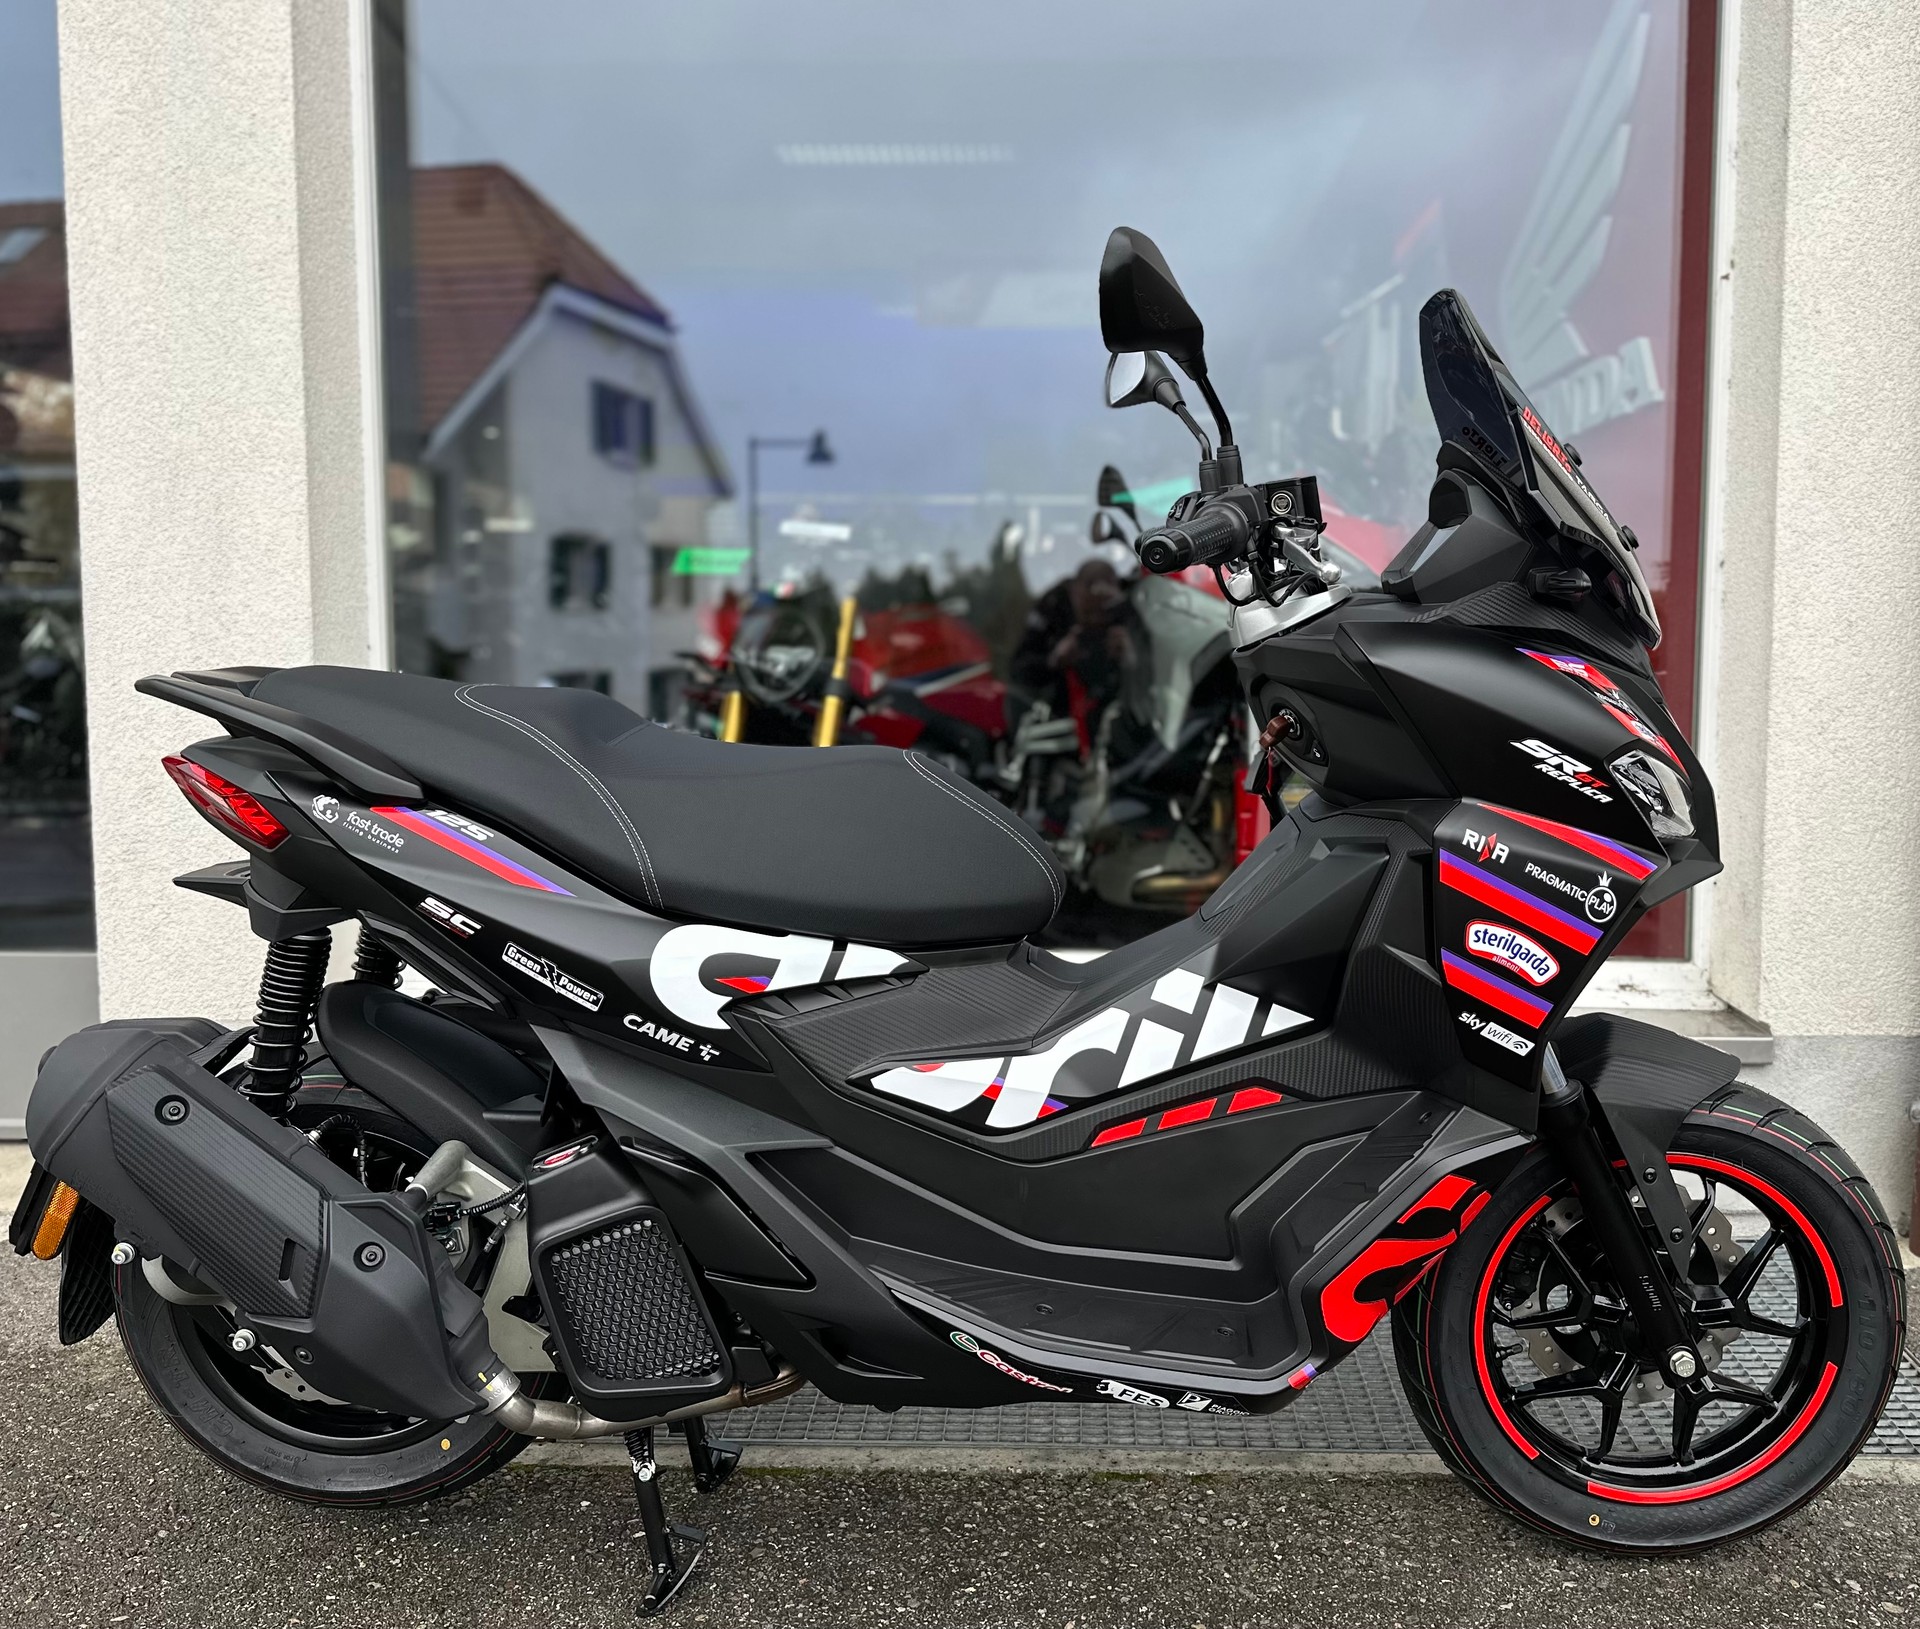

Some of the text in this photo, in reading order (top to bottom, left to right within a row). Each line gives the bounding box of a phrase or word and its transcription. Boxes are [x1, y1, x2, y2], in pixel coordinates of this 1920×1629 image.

[1534, 763, 1613, 803] REPLICA
[346, 811, 404, 848] fast trade
[425, 809, 495, 841] 125
[1525, 862, 1613, 915] PRAGMATIC PLAY
[420, 897, 481, 934] SC
[1473, 928, 1550, 976] sterilgarda
[1492, 956, 1520, 973] alimenti
[507, 946, 541, 973] Green
[559, 976, 597, 1002] Power
[623, 1014, 694, 1052] CAME
[1458, 1011, 1513, 1044] sky wifi
